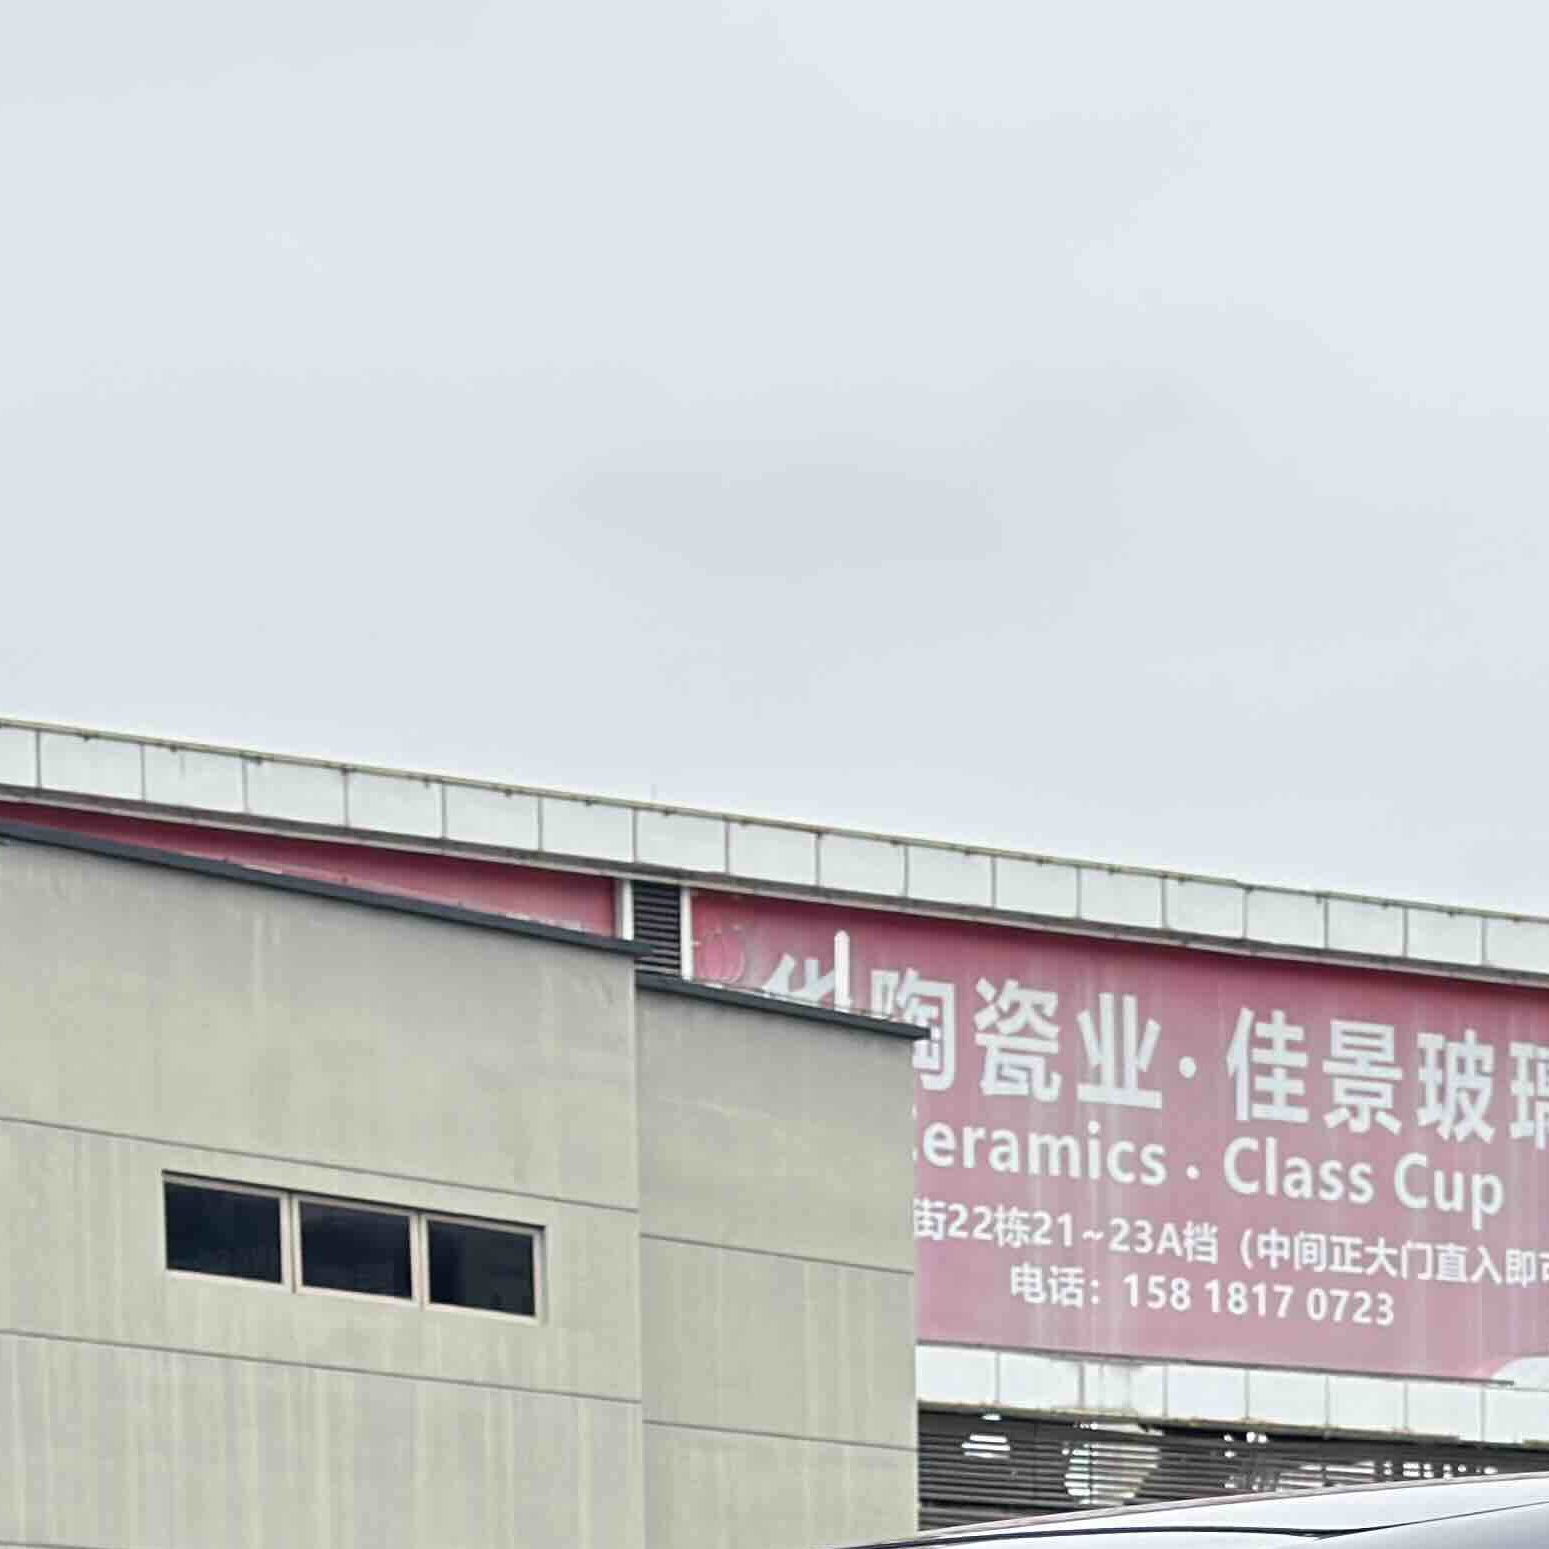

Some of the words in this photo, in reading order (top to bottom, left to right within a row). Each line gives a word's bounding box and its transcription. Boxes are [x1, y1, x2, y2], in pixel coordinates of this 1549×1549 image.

[913, 1116, 1167, 1187] eramics
[1224, 1136, 1376, 1206] Class
[1393, 1151, 1505, 1231] Cup
[1123, 1272, 1192, 1312] 158
[1205, 1279, 1293, 1320] 1817
[1306, 1288, 1396, 1327] 0723
